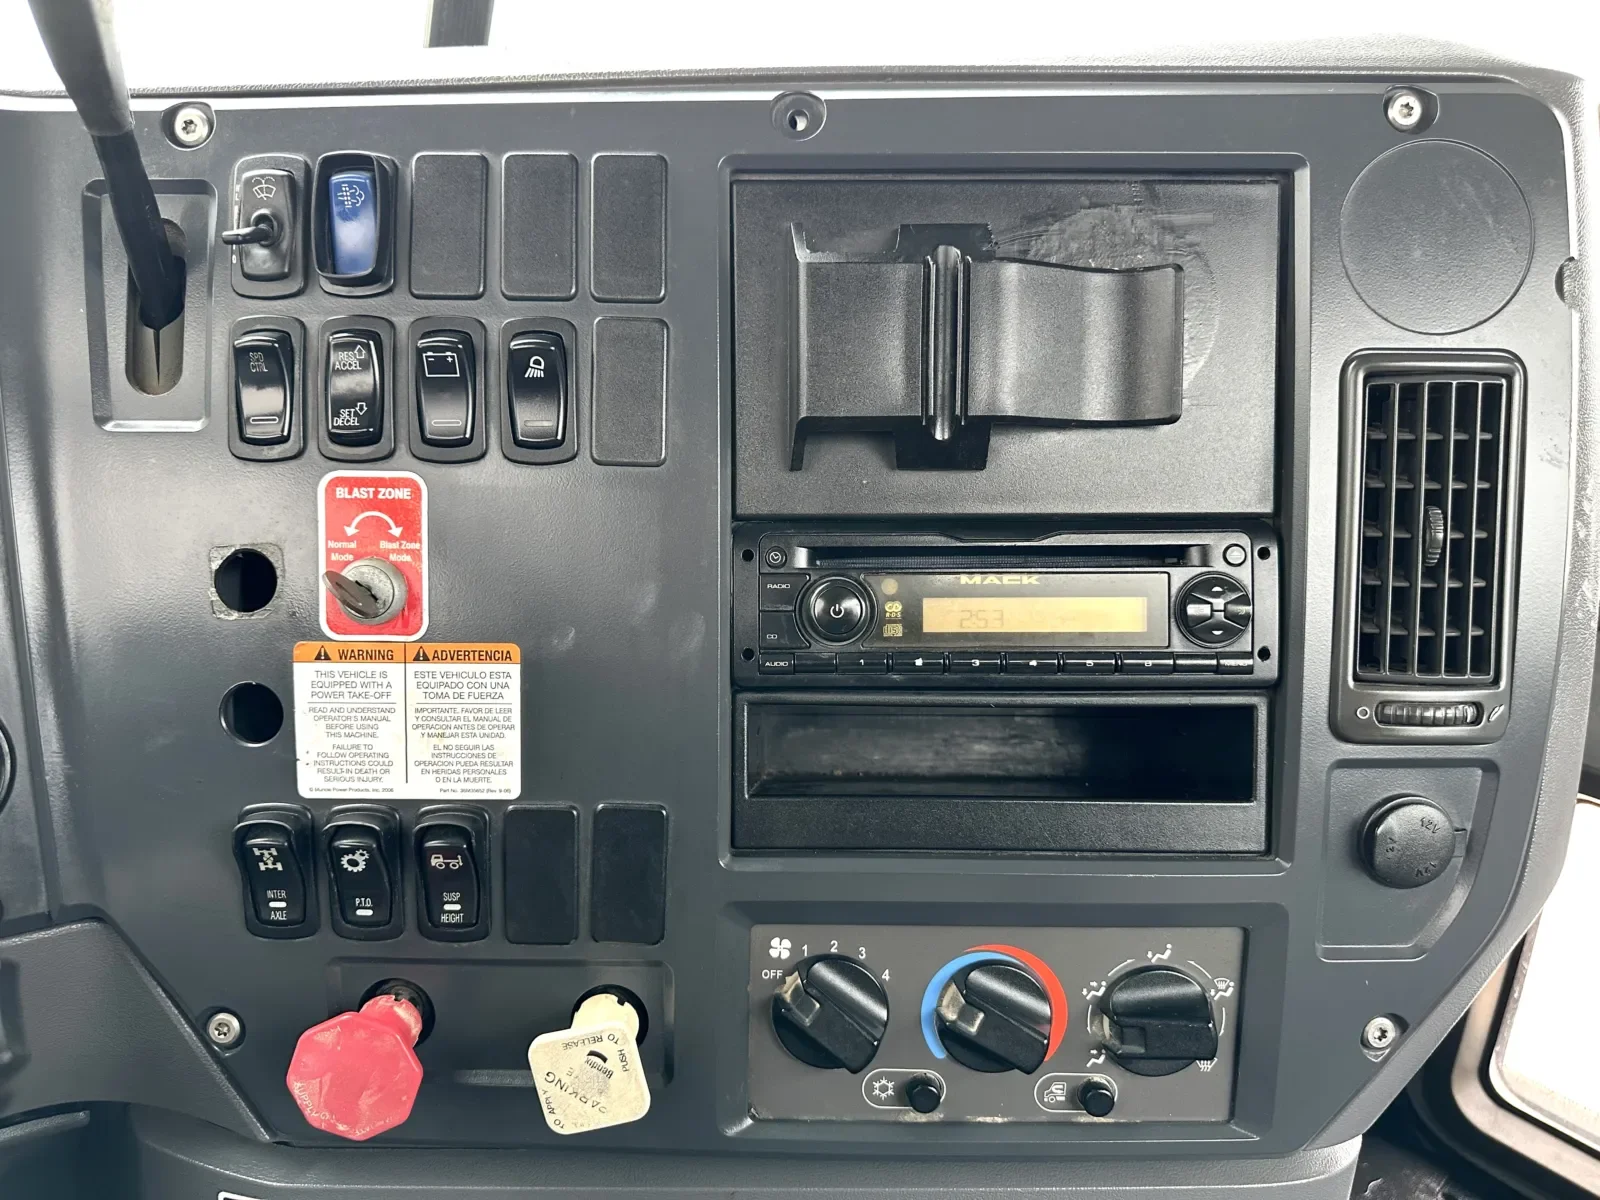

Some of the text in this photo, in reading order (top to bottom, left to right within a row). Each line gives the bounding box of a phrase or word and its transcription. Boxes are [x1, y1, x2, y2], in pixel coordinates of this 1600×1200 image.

[249, 352, 264, 362] SPD
[250, 363, 268, 372] CTRL
[334, 361, 362, 370] ACCEL
[339, 409, 355, 418] SET
[333, 417, 360, 426] DECEL
[335, 487, 412, 499] BLAST ZONE
[328, 540, 357, 549] Normal
[379, 541, 420, 549] Blast Zone
[331, 553, 354, 561] Mode
[960, 575, 1040, 585] MACK
[338, 649, 394, 661] WARNING
[432, 650, 512, 661] ADVERTENCIA
[314, 670, 388, 679] THIS VEHICLE IS
[414, 671, 512, 679] ESTE VEHICULO ESTA
[311, 681, 393, 689] EQUIPPED WITH A
[311, 691, 392, 699] POWER TAKE-OFF
[423, 692, 504, 700] TOMA DE FUERZA
[267, 890, 286, 899] INTER
[443, 892, 461, 901] SUSP
[355, 898, 373, 907] P.T.O.
[270, 911, 287, 920] AXLE
[440, 913, 464, 923] HEIGHT
[802, 944, 808, 956] 1
[830, 940, 838, 953] 2
[858, 947, 866, 959] 3
[761, 969, 783, 979] OFF
[882, 969, 890, 981] 4
[562, 1034, 629, 1072] PUSH TO RELEASE
[584, 1058, 614, 1079] Bendix
[554, 1118, 565, 1129] TO
